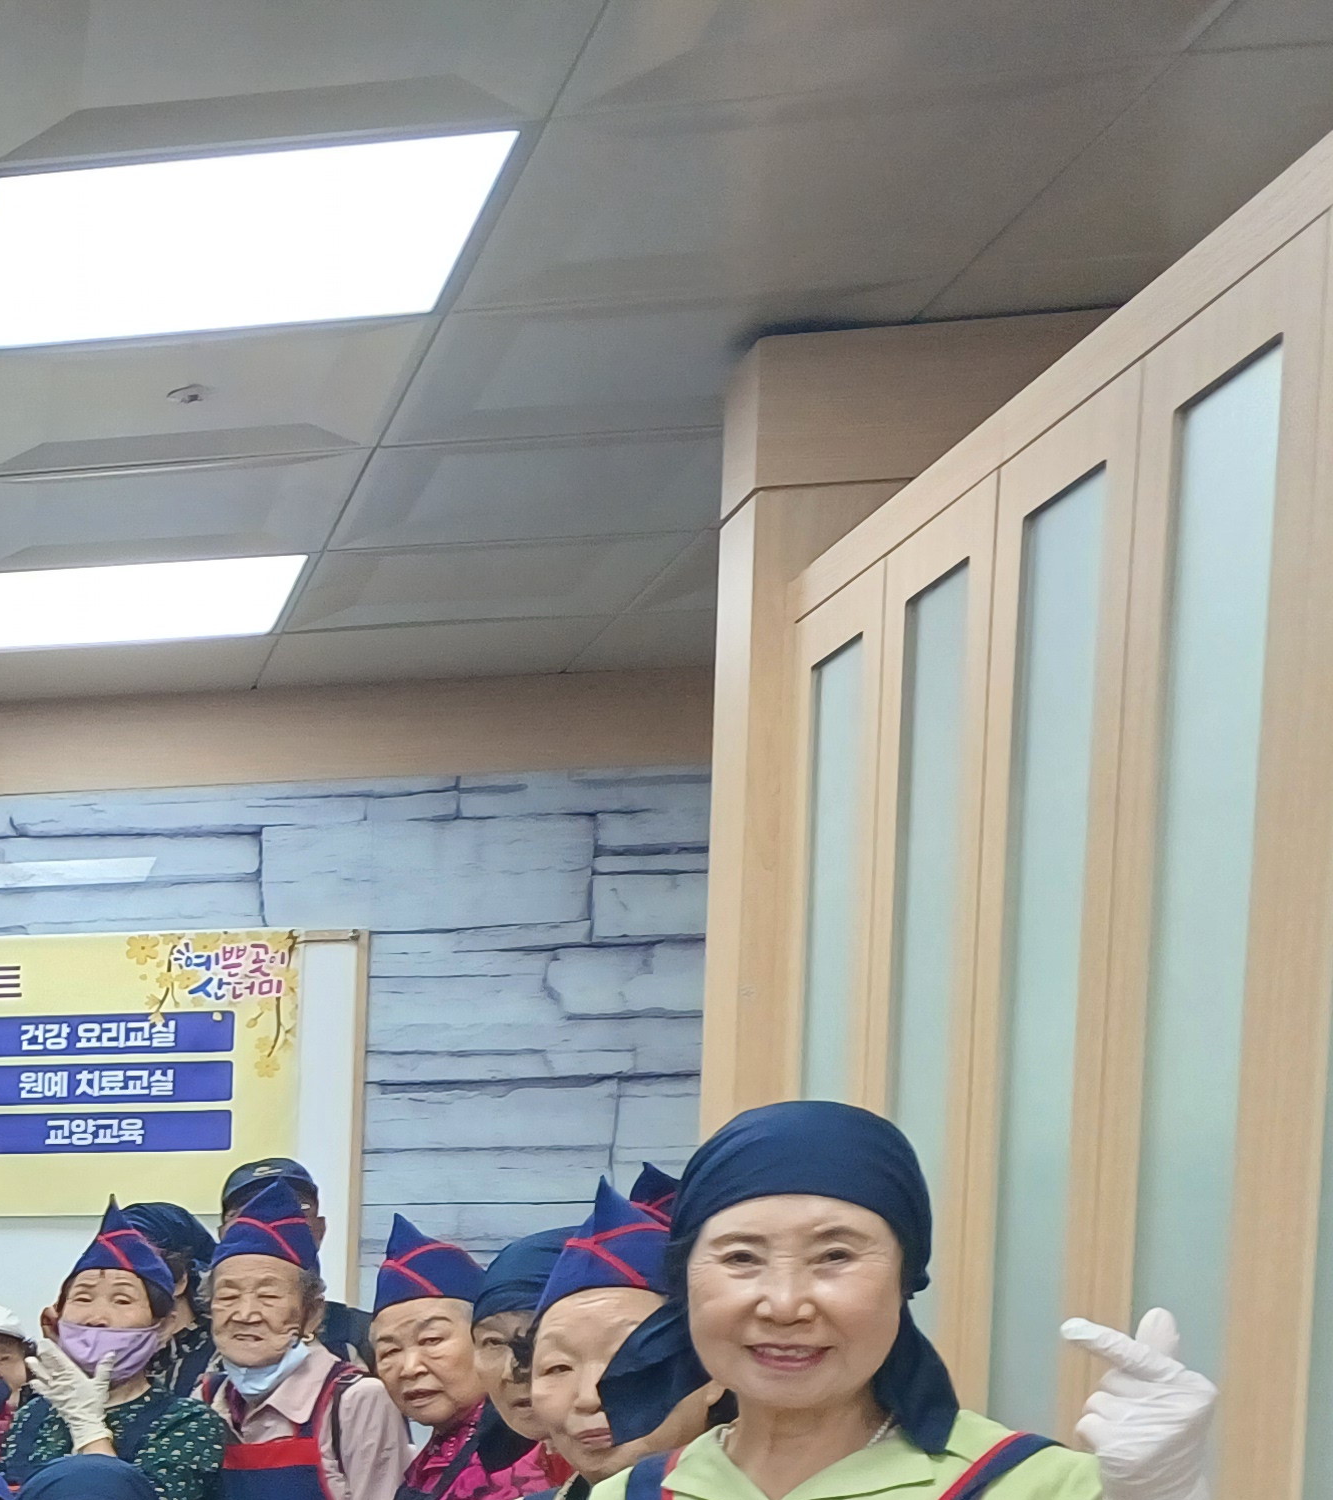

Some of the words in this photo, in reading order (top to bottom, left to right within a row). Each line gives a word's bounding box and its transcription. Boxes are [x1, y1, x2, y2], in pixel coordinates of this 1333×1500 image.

[20, 1022, 71, 1050] 건강
[75, 1020, 177, 1048] 요리교실
[19, 1071, 69, 1099] 원예
[75, 1069, 175, 1097] 치료교실
[45, 1119, 145, 1145] 교양교육
